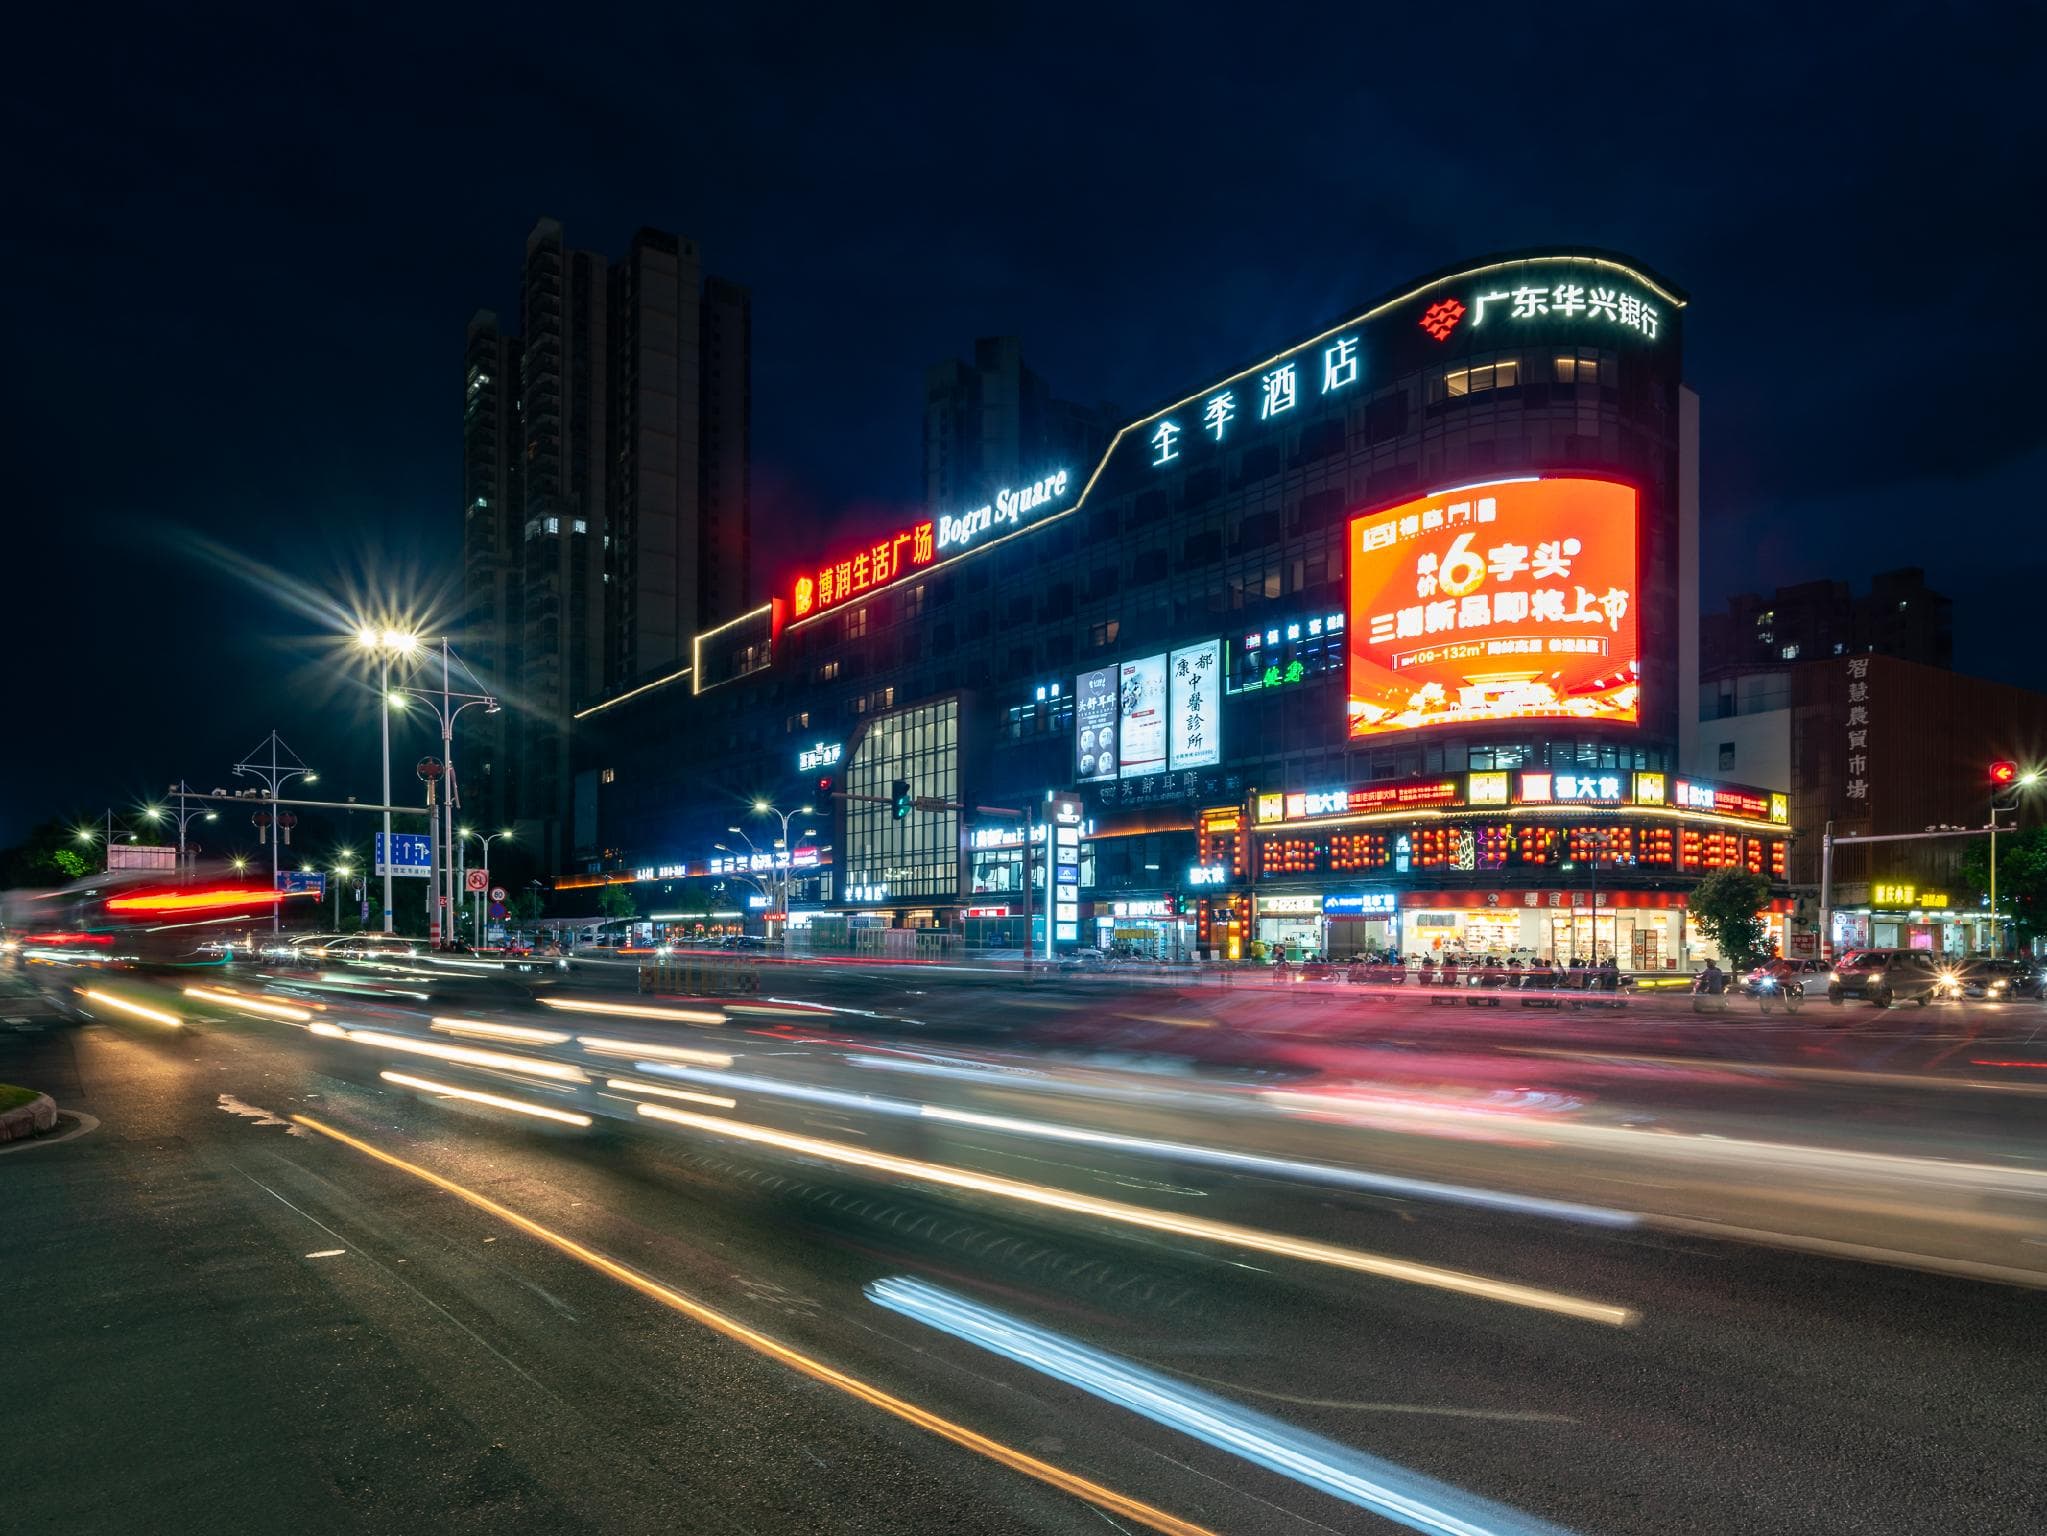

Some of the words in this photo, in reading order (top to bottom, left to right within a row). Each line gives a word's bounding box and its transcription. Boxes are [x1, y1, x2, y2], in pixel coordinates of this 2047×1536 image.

[1472, 284, 1660, 340] 广东华兴银行
[1151, 335, 1360, 467] 全季酒店
[993, 469, 1068, 525] Square
[818, 521, 933, 608] 博润生活广场
[1369, 585, 1630, 645] 三期新品即将上市
[1846, 657, 1870, 799] 智慧農貿市場
